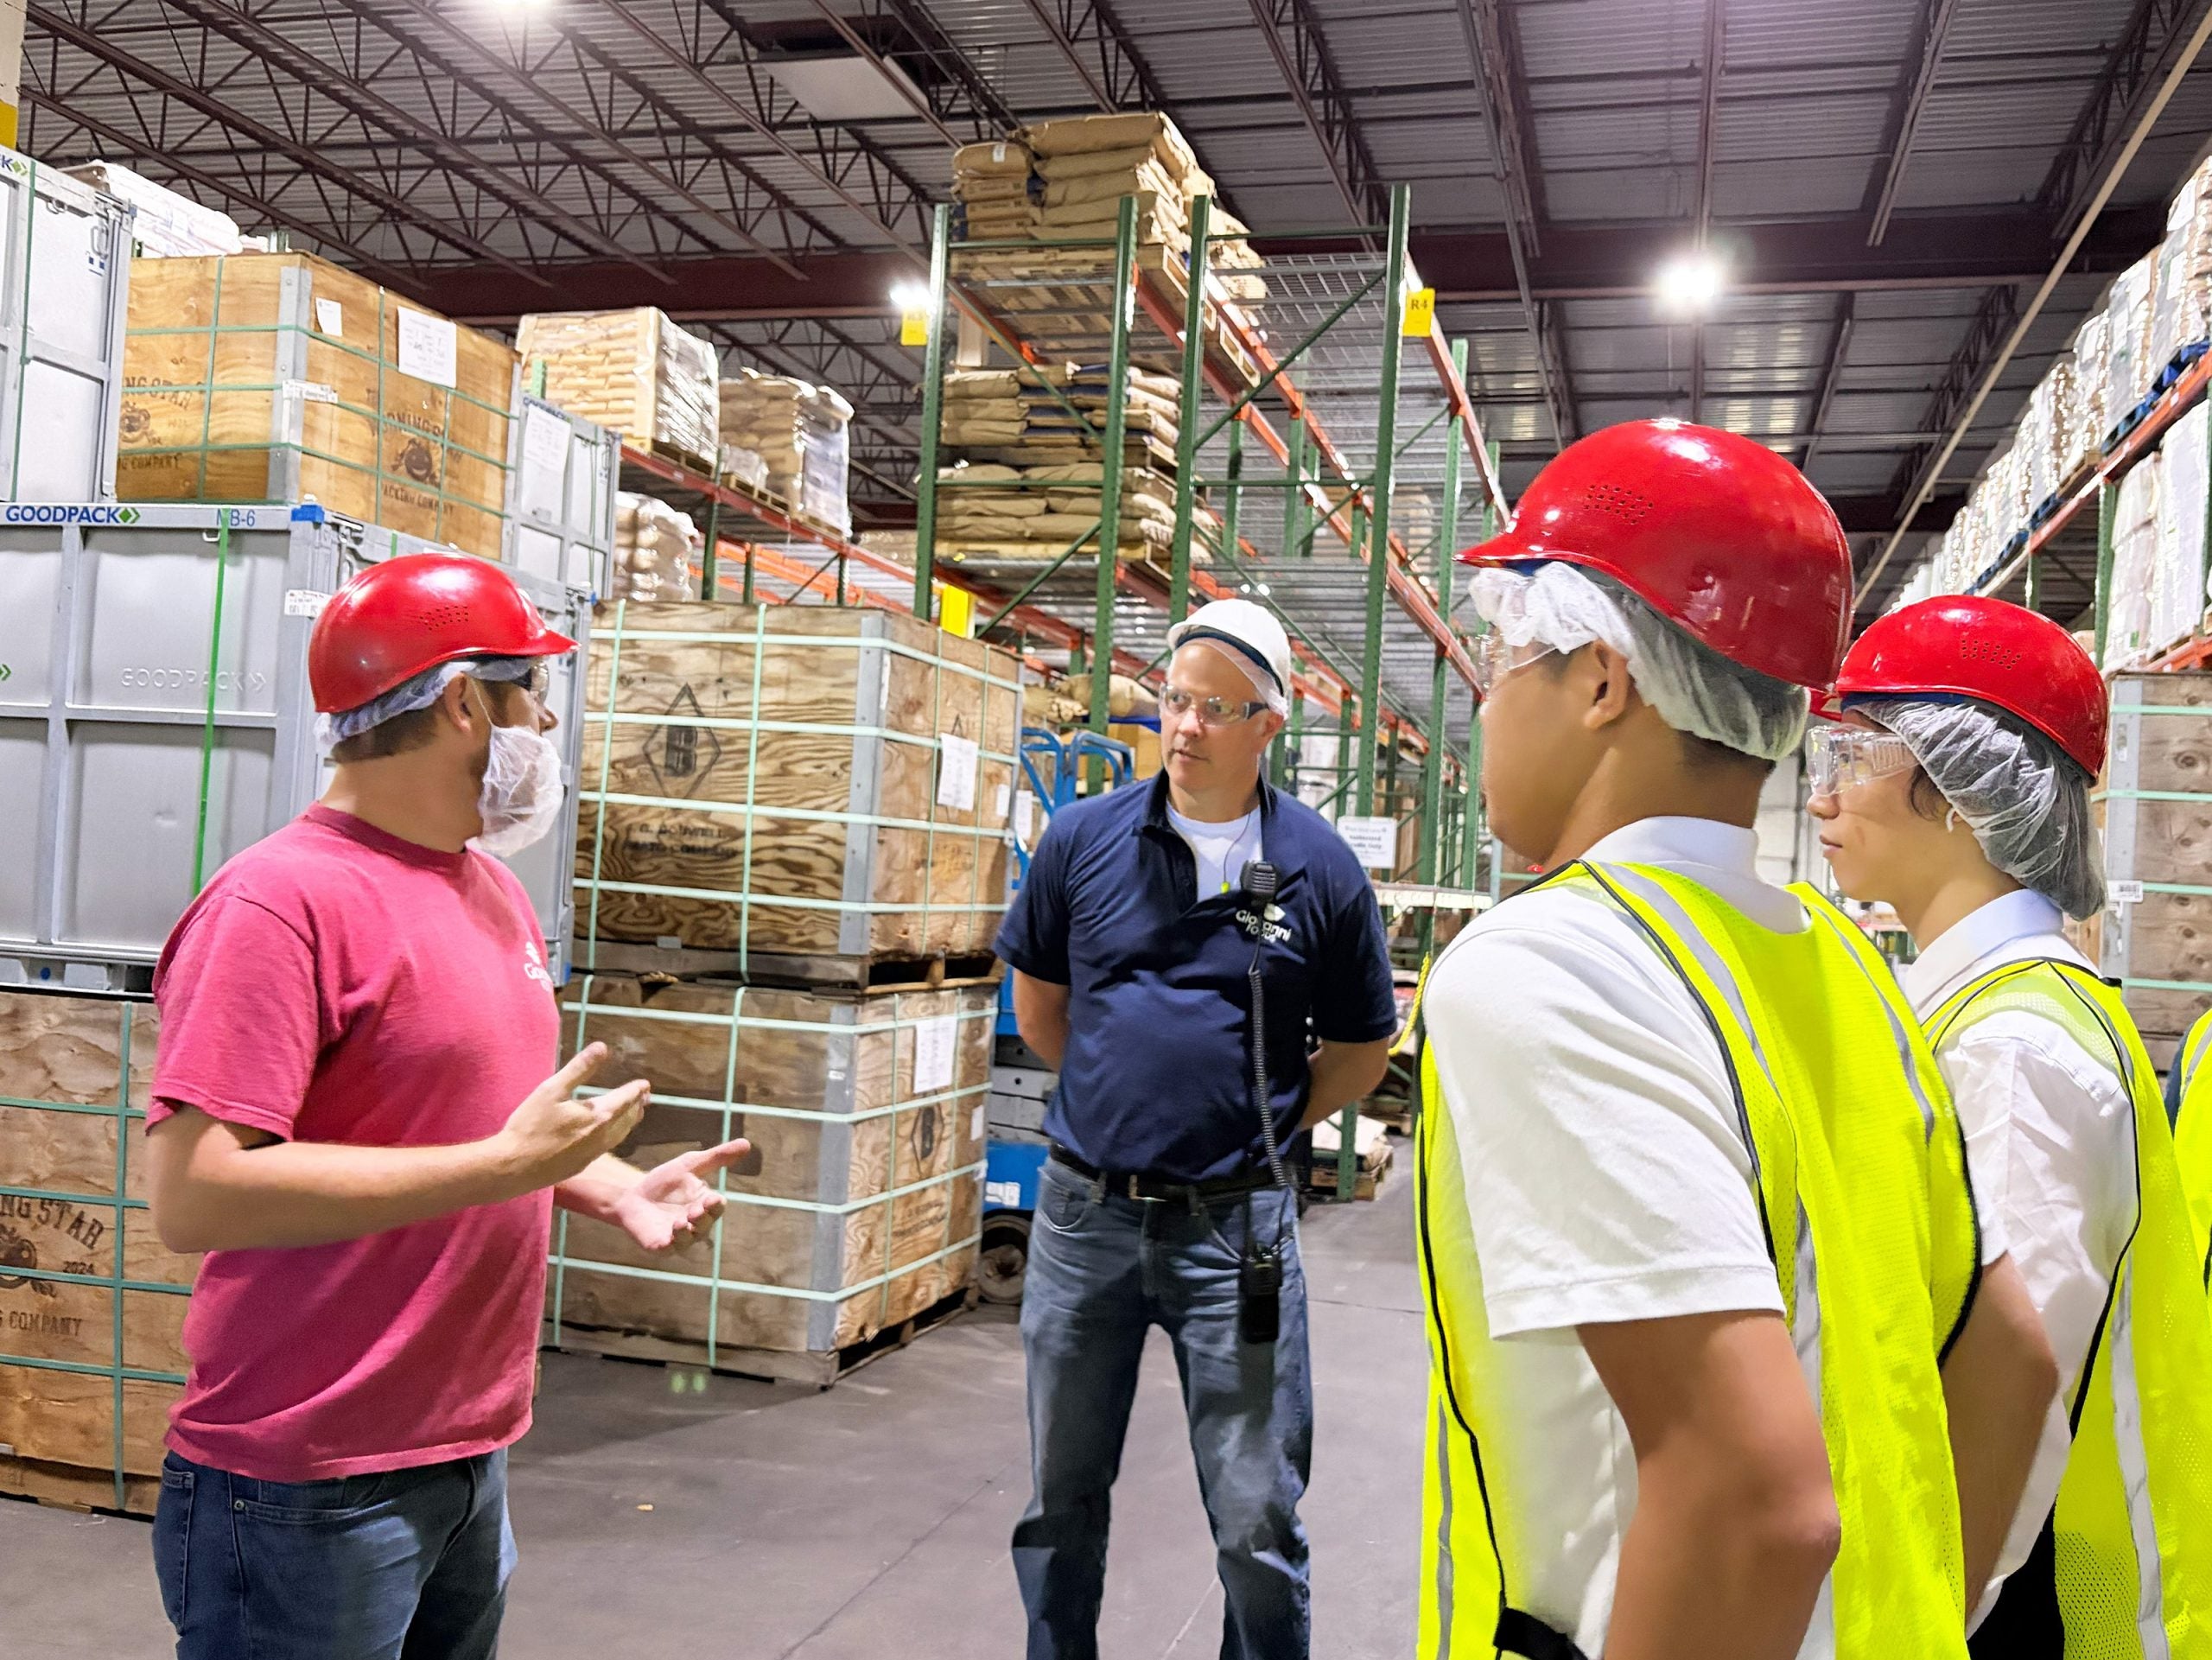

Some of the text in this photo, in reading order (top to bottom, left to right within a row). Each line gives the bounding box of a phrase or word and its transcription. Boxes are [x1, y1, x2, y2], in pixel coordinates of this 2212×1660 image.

[1411, 299, 1427, 309] R4
[6, 506, 120, 524] GOODPACK
[1235, 909, 1292, 942] Gioanni
[37, 1200, 104, 1250] STAR
[10, 1311, 83, 1337] COMPANY
